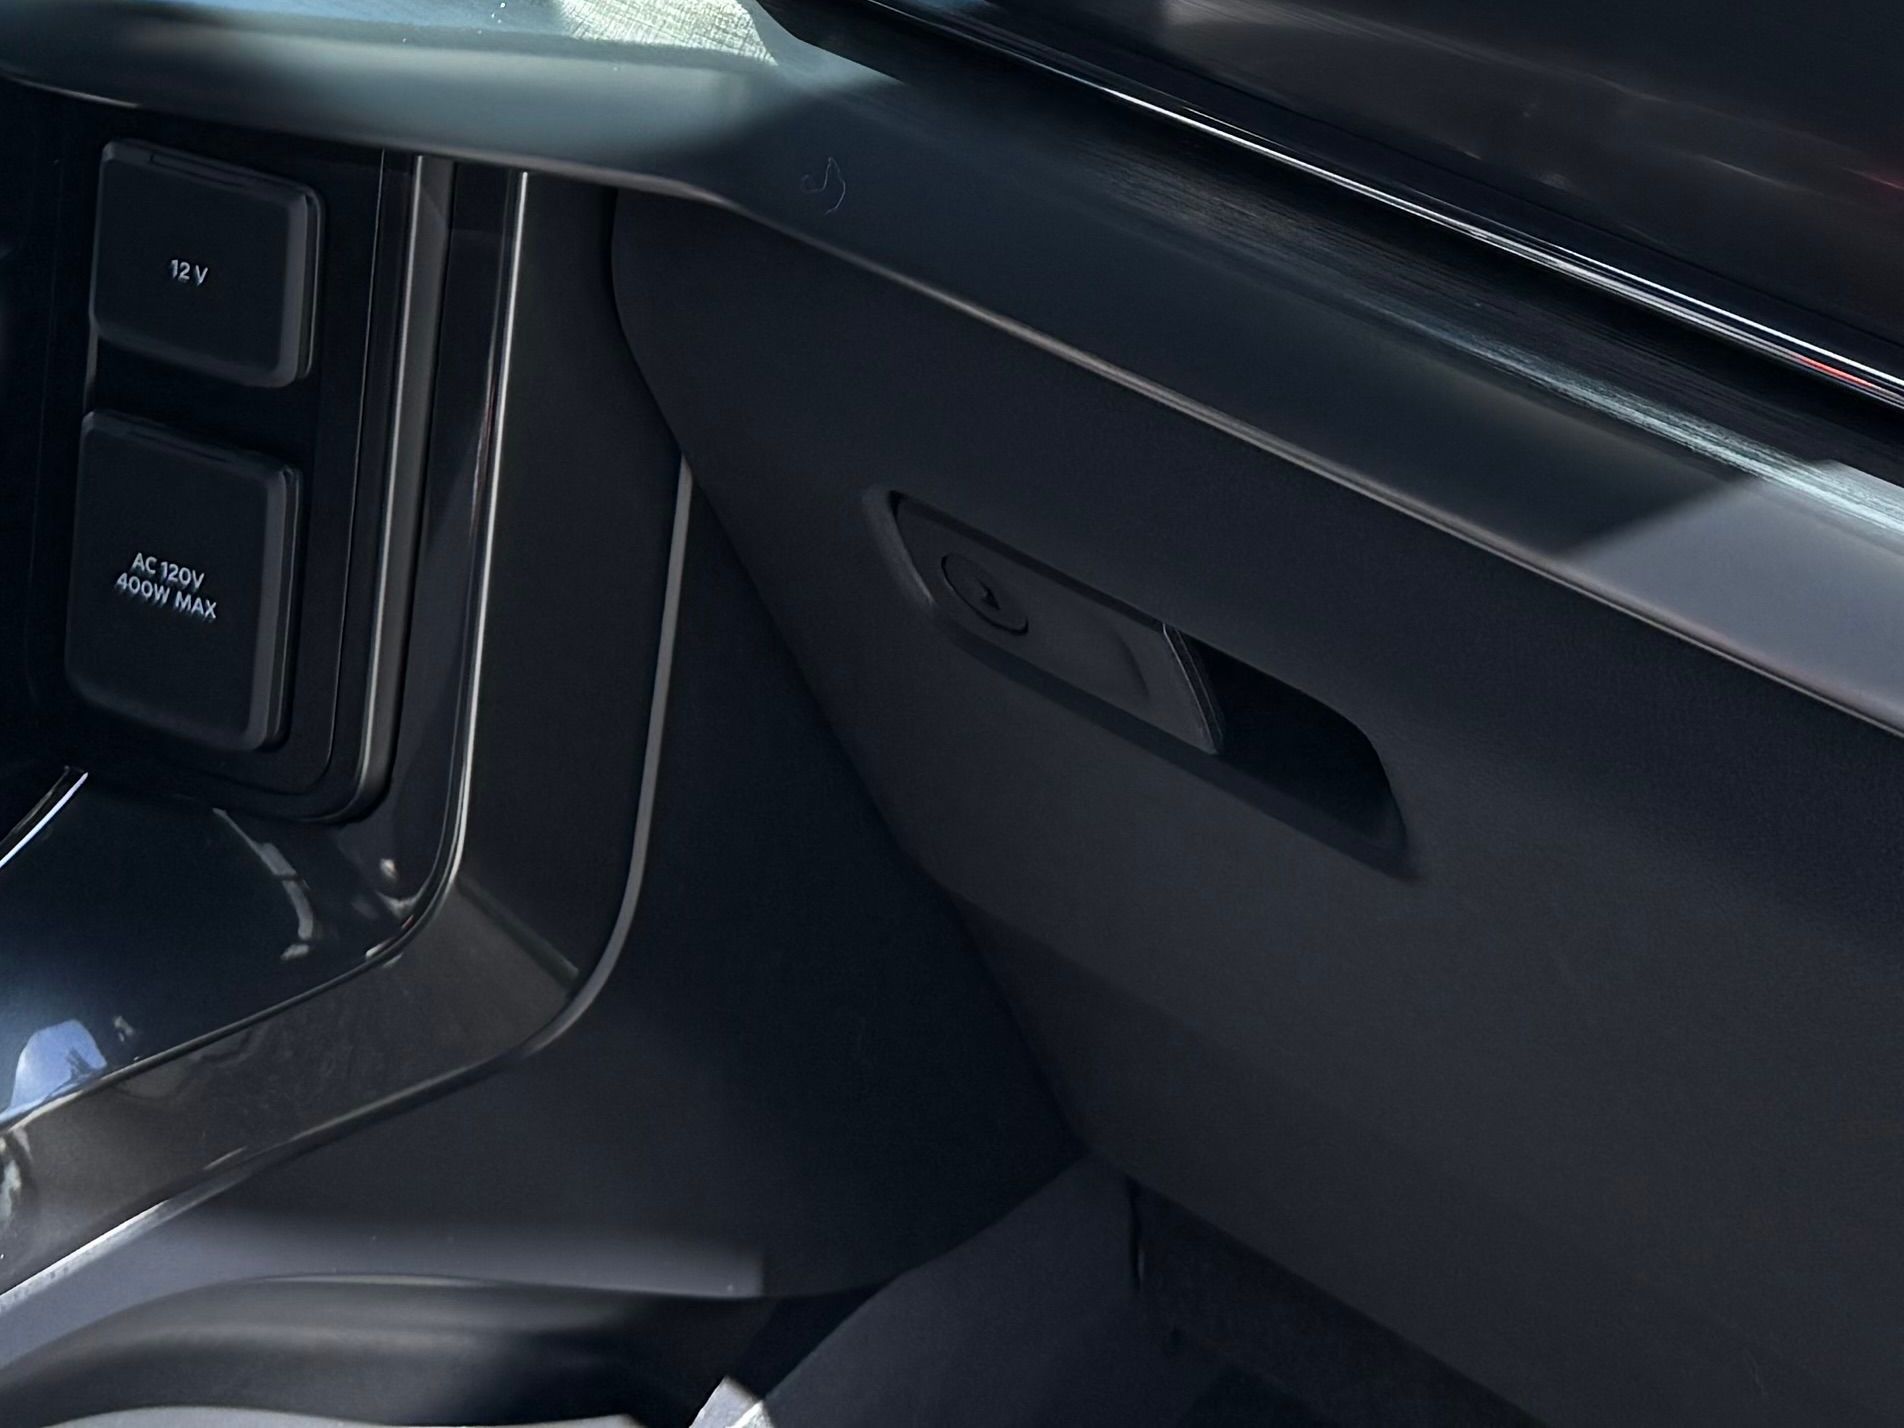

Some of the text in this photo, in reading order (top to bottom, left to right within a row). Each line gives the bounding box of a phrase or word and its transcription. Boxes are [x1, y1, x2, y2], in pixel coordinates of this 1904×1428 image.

[170, 259, 209, 286] 12 V
[131, 552, 205, 589] AC 120V
[115, 572, 217, 620] 400W MAX
